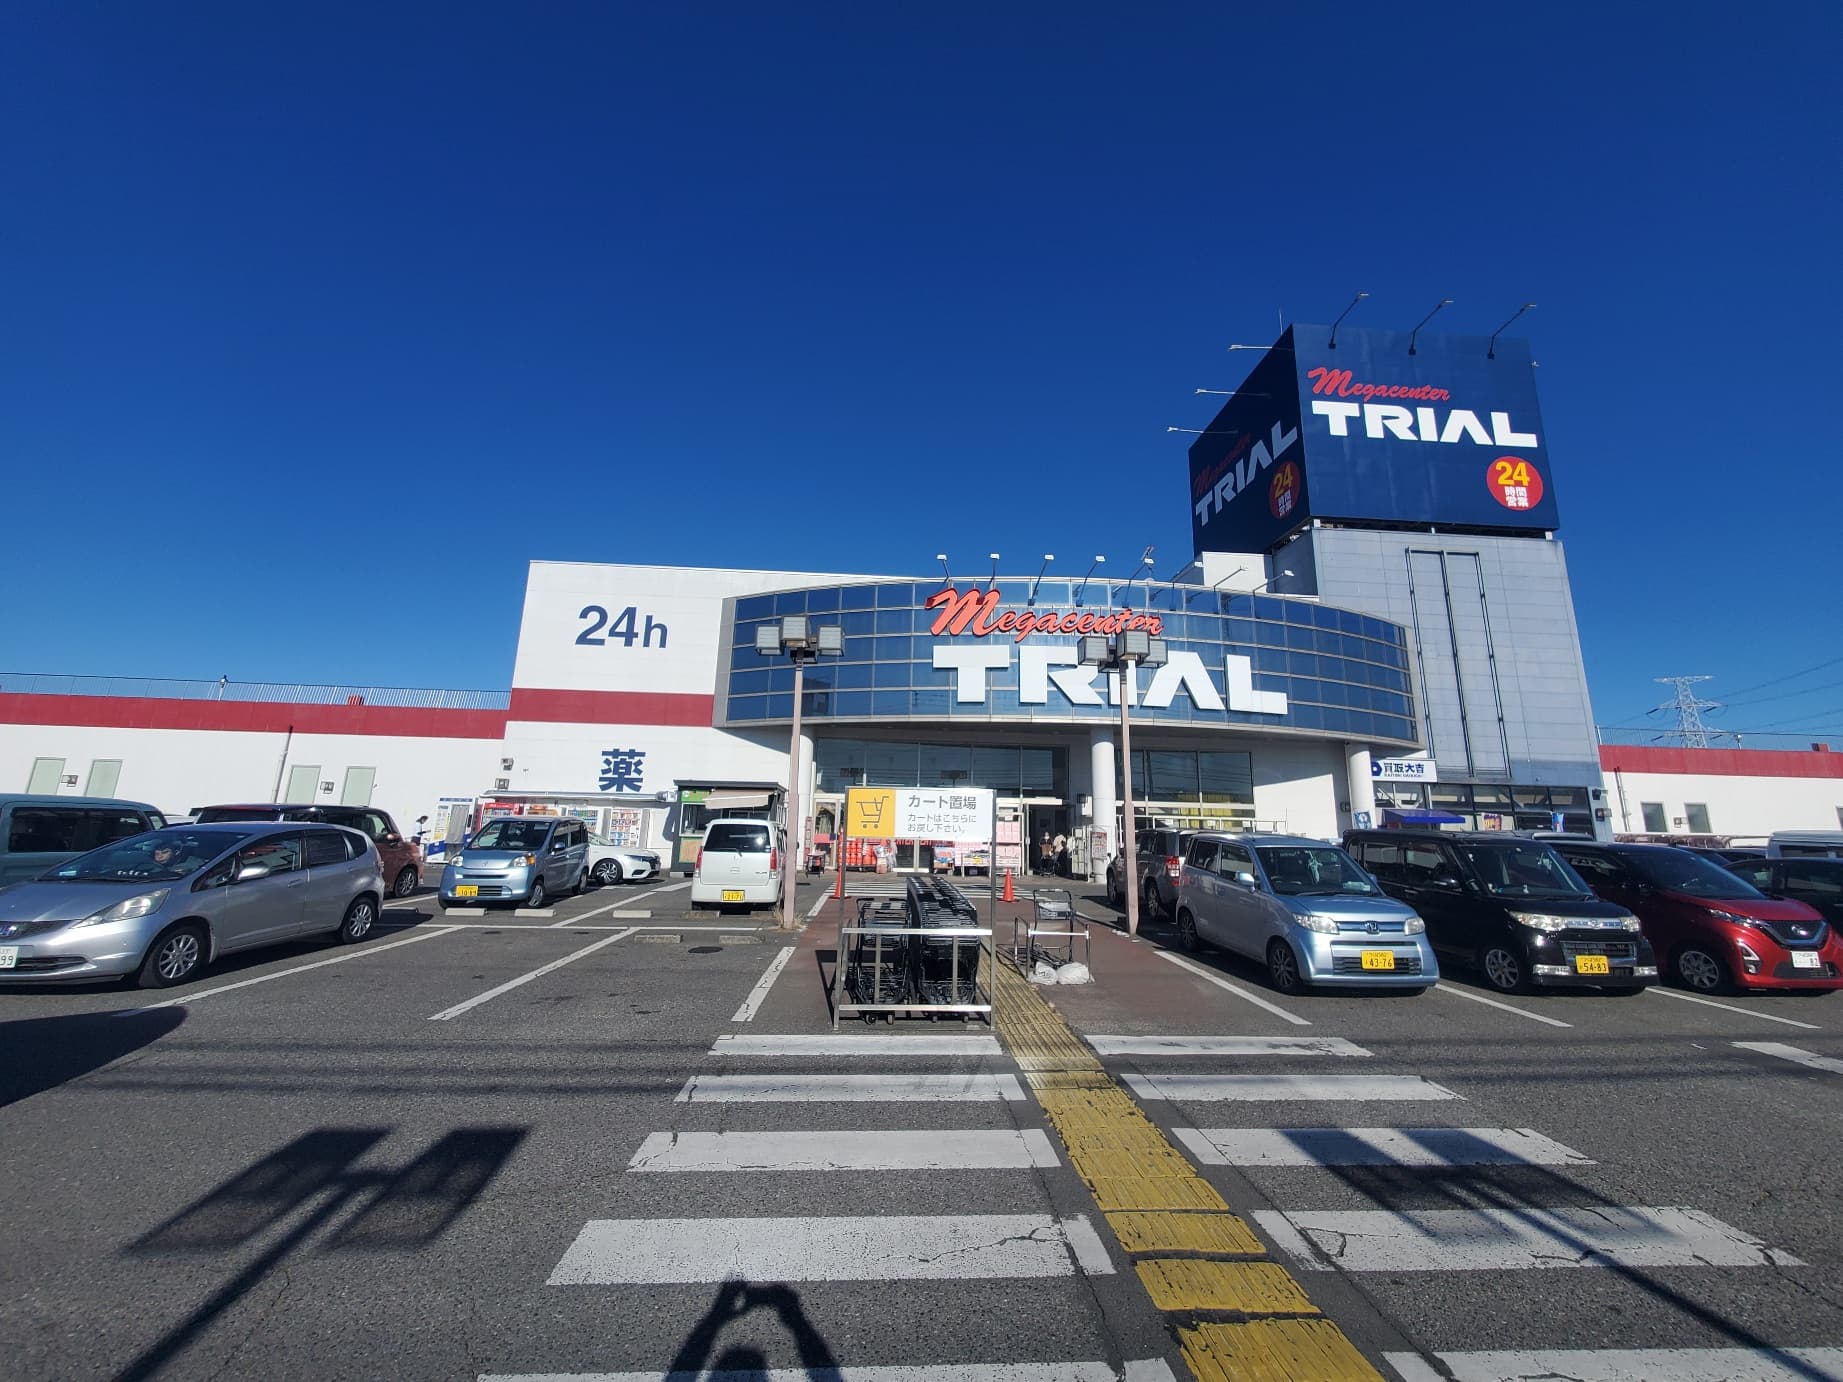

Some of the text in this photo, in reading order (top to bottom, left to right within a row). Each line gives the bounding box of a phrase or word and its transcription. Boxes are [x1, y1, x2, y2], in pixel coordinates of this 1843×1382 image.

[1308, 367, 1450, 402] Megacenter
[1312, 400, 1538, 448] TRIAL
[1195, 420, 1298, 527] TRIAL
[1274, 463, 1293, 498] 24
[1495, 461, 1530, 486] 24
[575, 605, 668, 648] 24h
[925, 588, 1165, 643] Megacenter
[932, 645, 1289, 715] TRIAL
[599, 749, 646, 792] 薬
[907, 814, 977, 823] カートはこちらに
[908, 795, 977, 810] カート置場
[907, 823, 965, 833] お戻し下さい。
